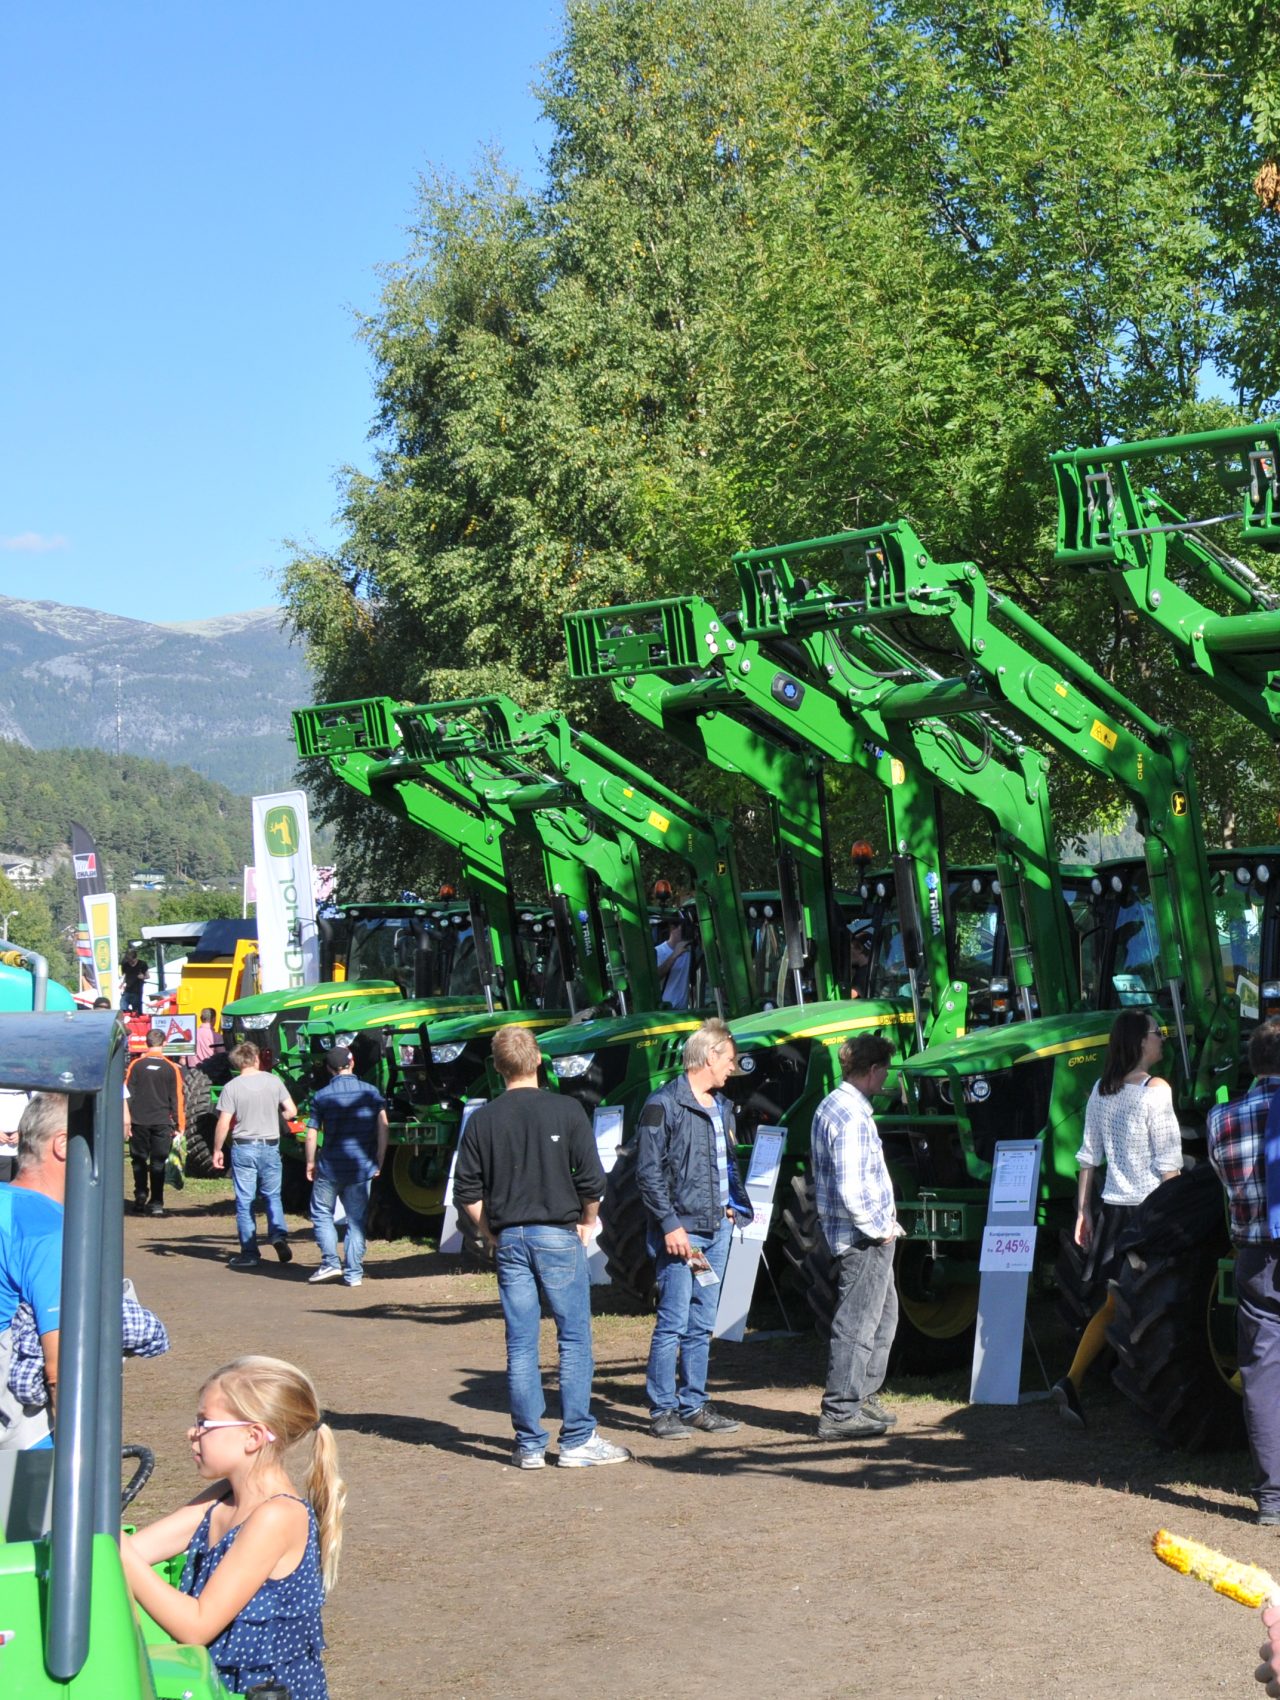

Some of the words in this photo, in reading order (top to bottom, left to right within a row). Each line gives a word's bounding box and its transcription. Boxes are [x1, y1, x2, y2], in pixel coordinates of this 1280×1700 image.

[928, 889, 942, 936] TRIMA
[582, 923, 593, 957] TRIMA
[995, 1239, 1030, 1255] 2,45%
